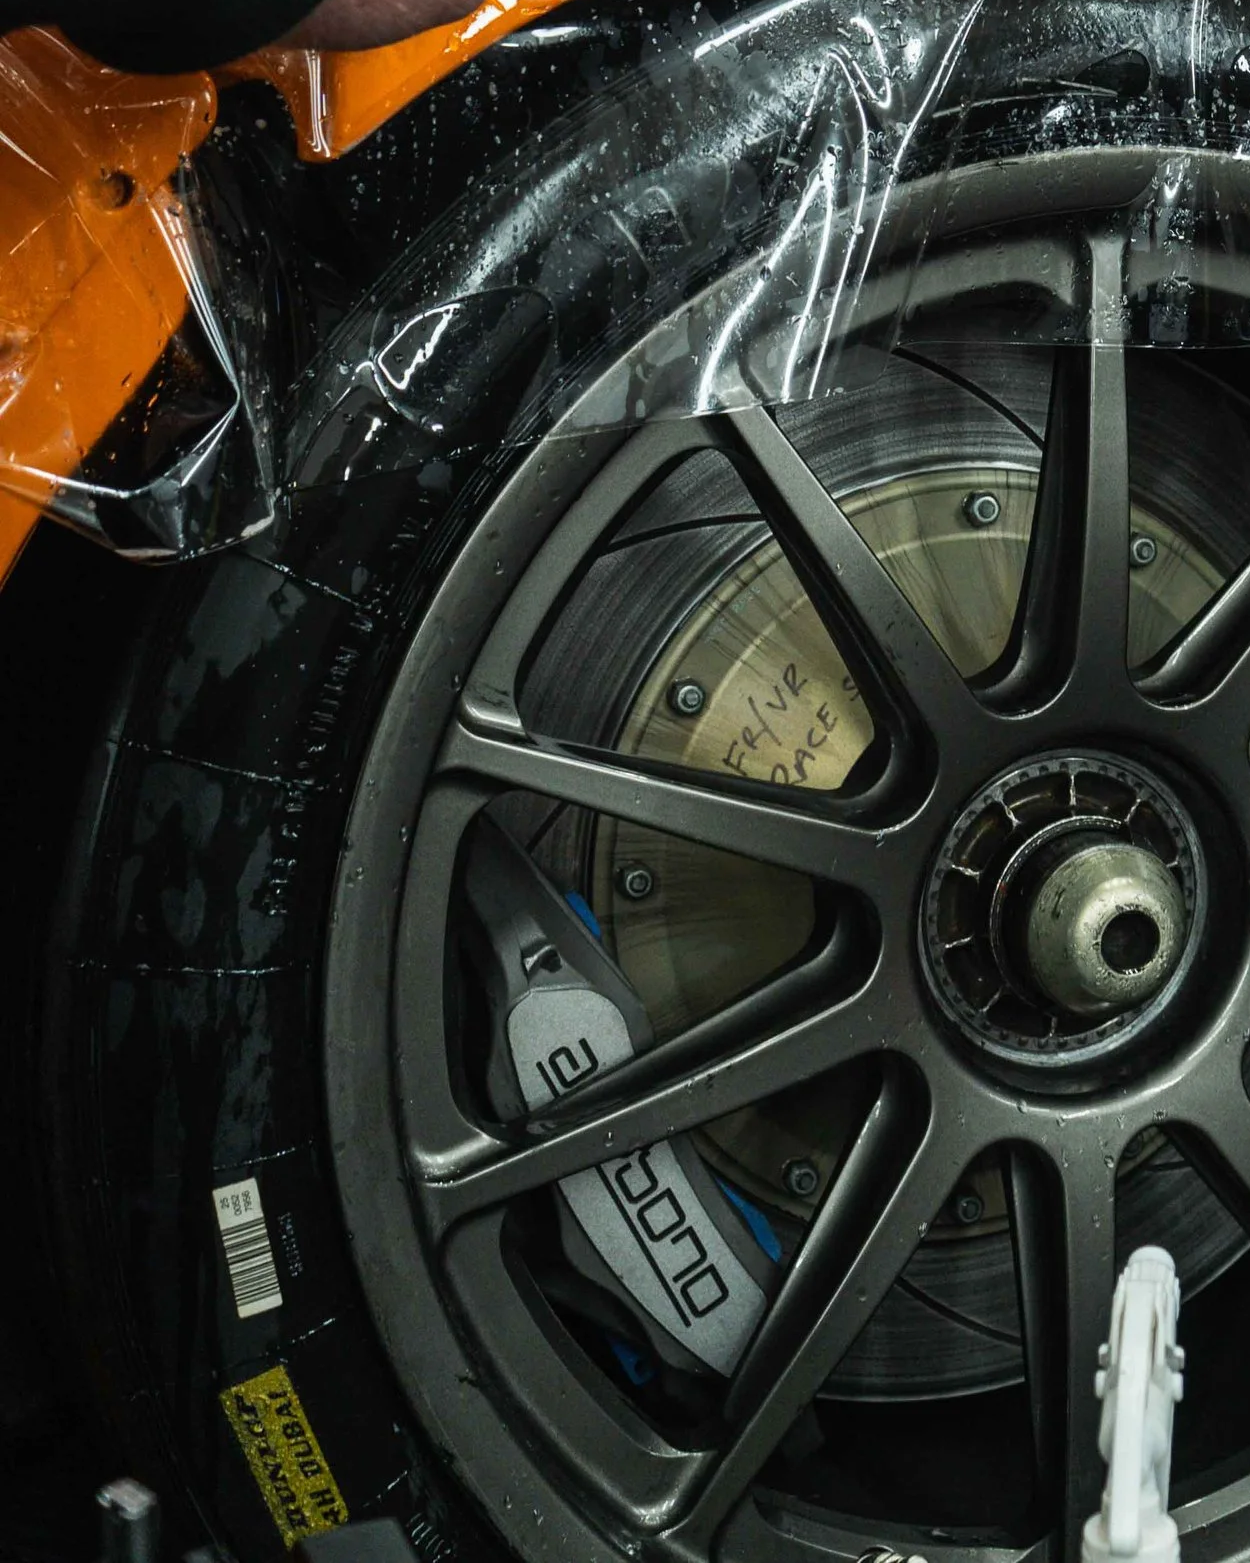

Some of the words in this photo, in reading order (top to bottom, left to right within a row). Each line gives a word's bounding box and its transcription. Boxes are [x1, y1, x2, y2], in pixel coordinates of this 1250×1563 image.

[220, 1197, 230, 1209] 25
[232, 1392, 310, 1533] DUNLOP
[267, 1388, 323, 1481] DUBAI
